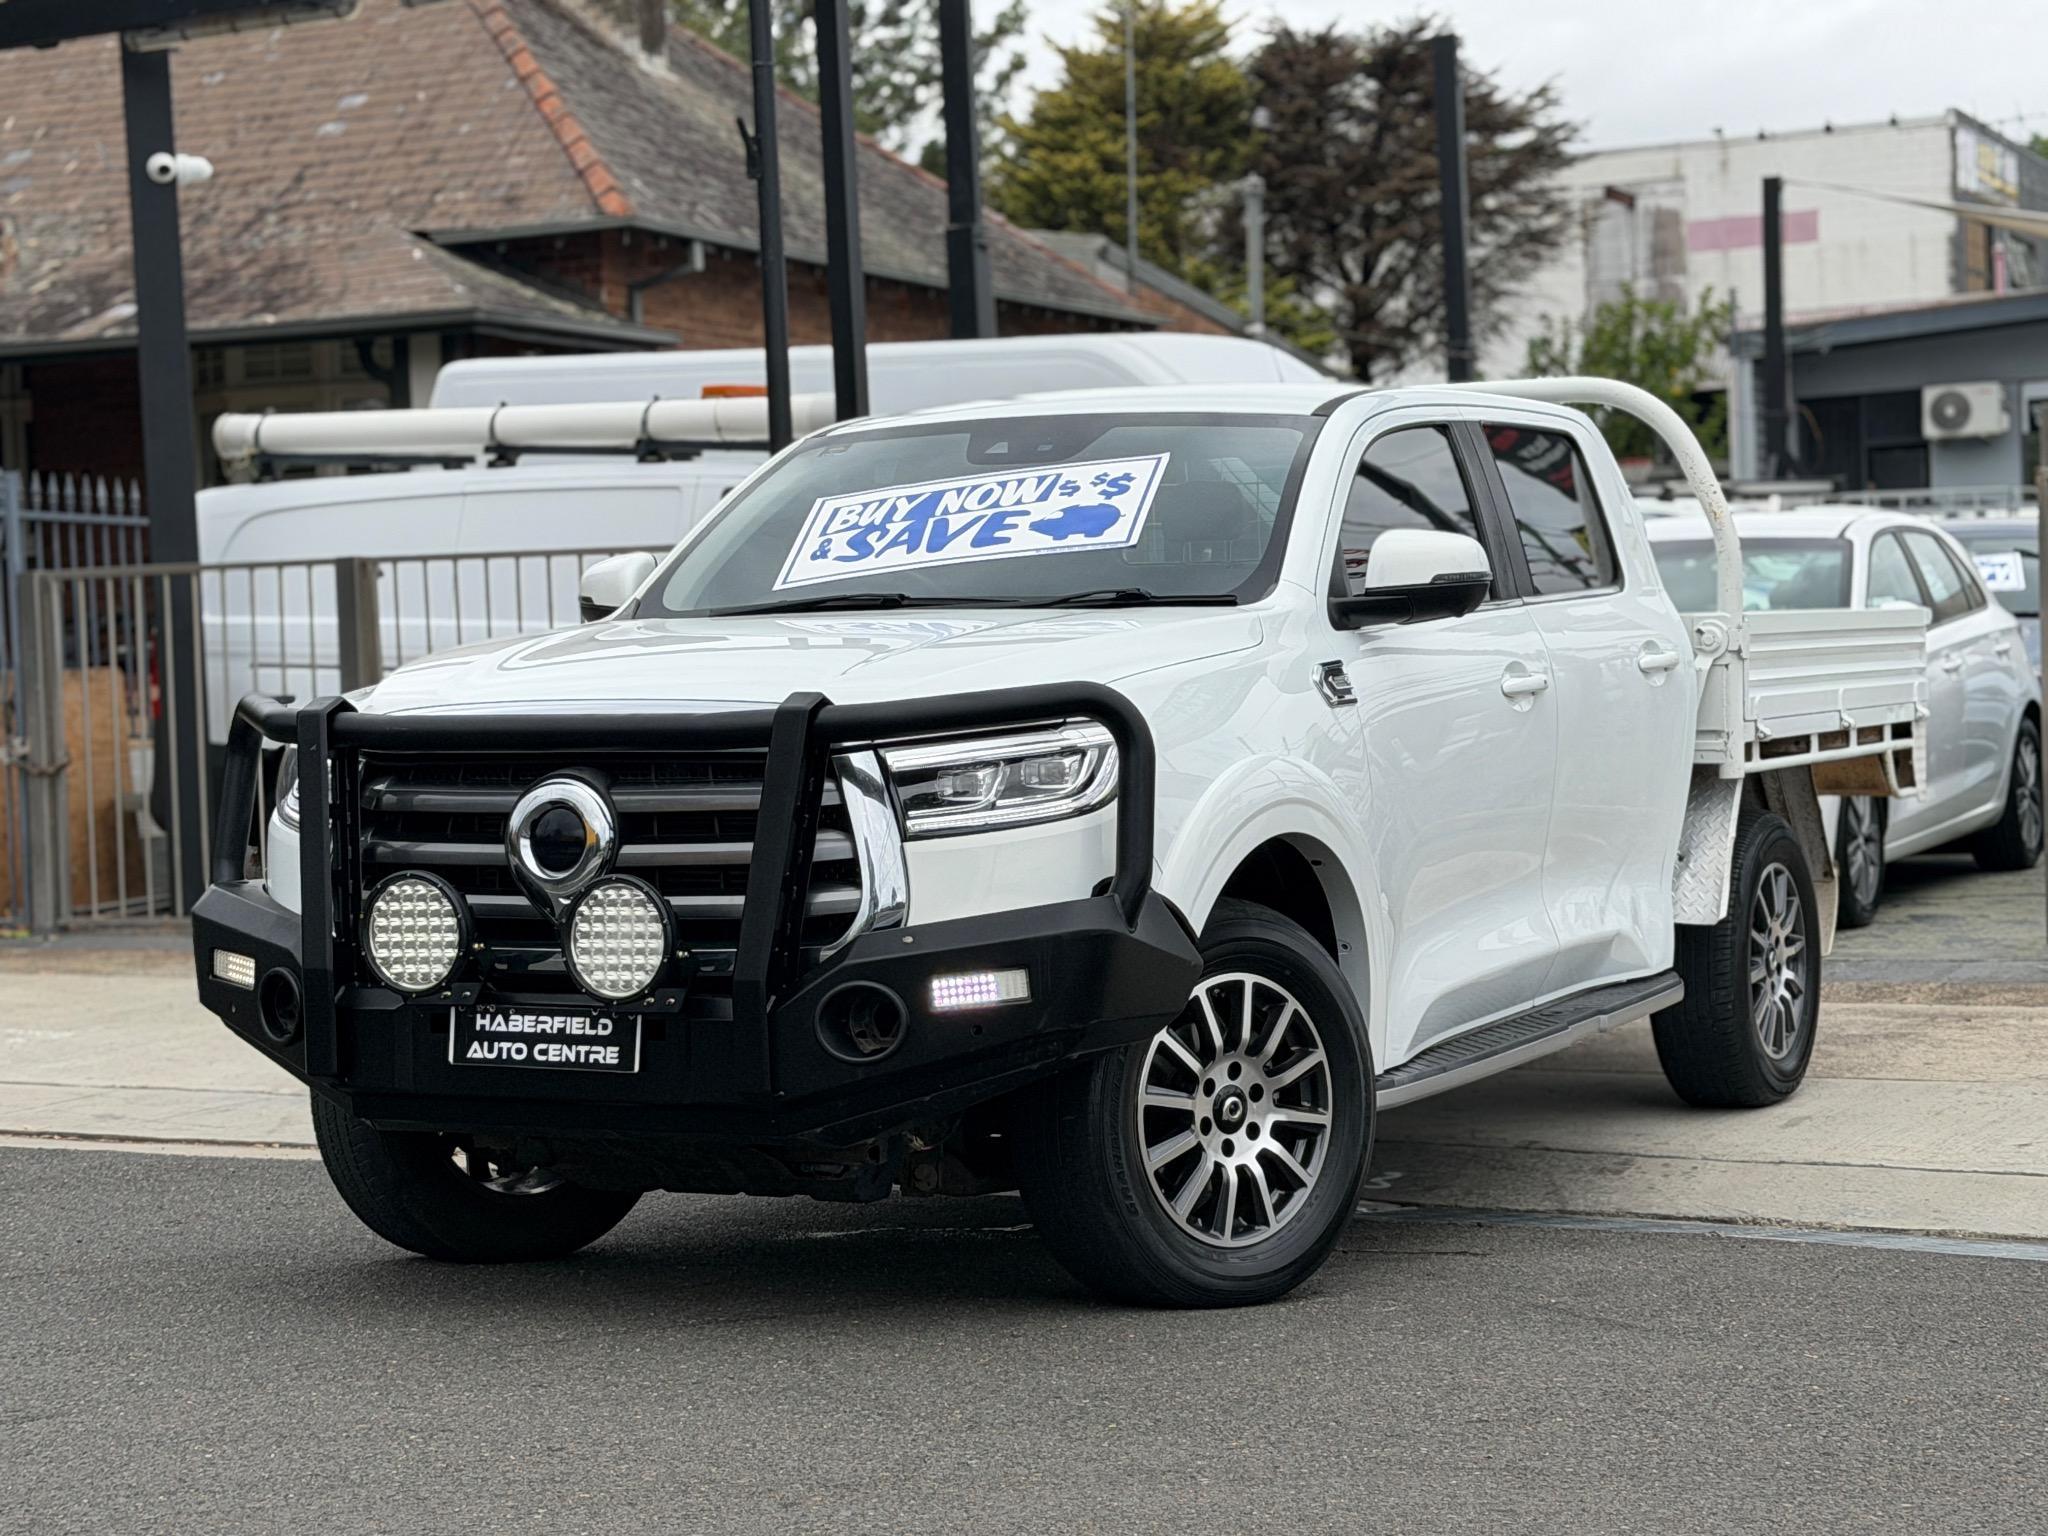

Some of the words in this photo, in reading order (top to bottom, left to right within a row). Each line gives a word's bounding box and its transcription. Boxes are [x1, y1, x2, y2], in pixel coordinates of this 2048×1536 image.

[825, 493, 931, 534] BUY
[935, 475, 1058, 516] NOW
[810, 538, 833, 561] &
[832, 509, 1031, 562] SAVE
[475, 1013, 613, 1036] HABERFIELD
[466, 1040, 528, 1061] AUTO
[533, 1043, 620, 1065] CENTRE
